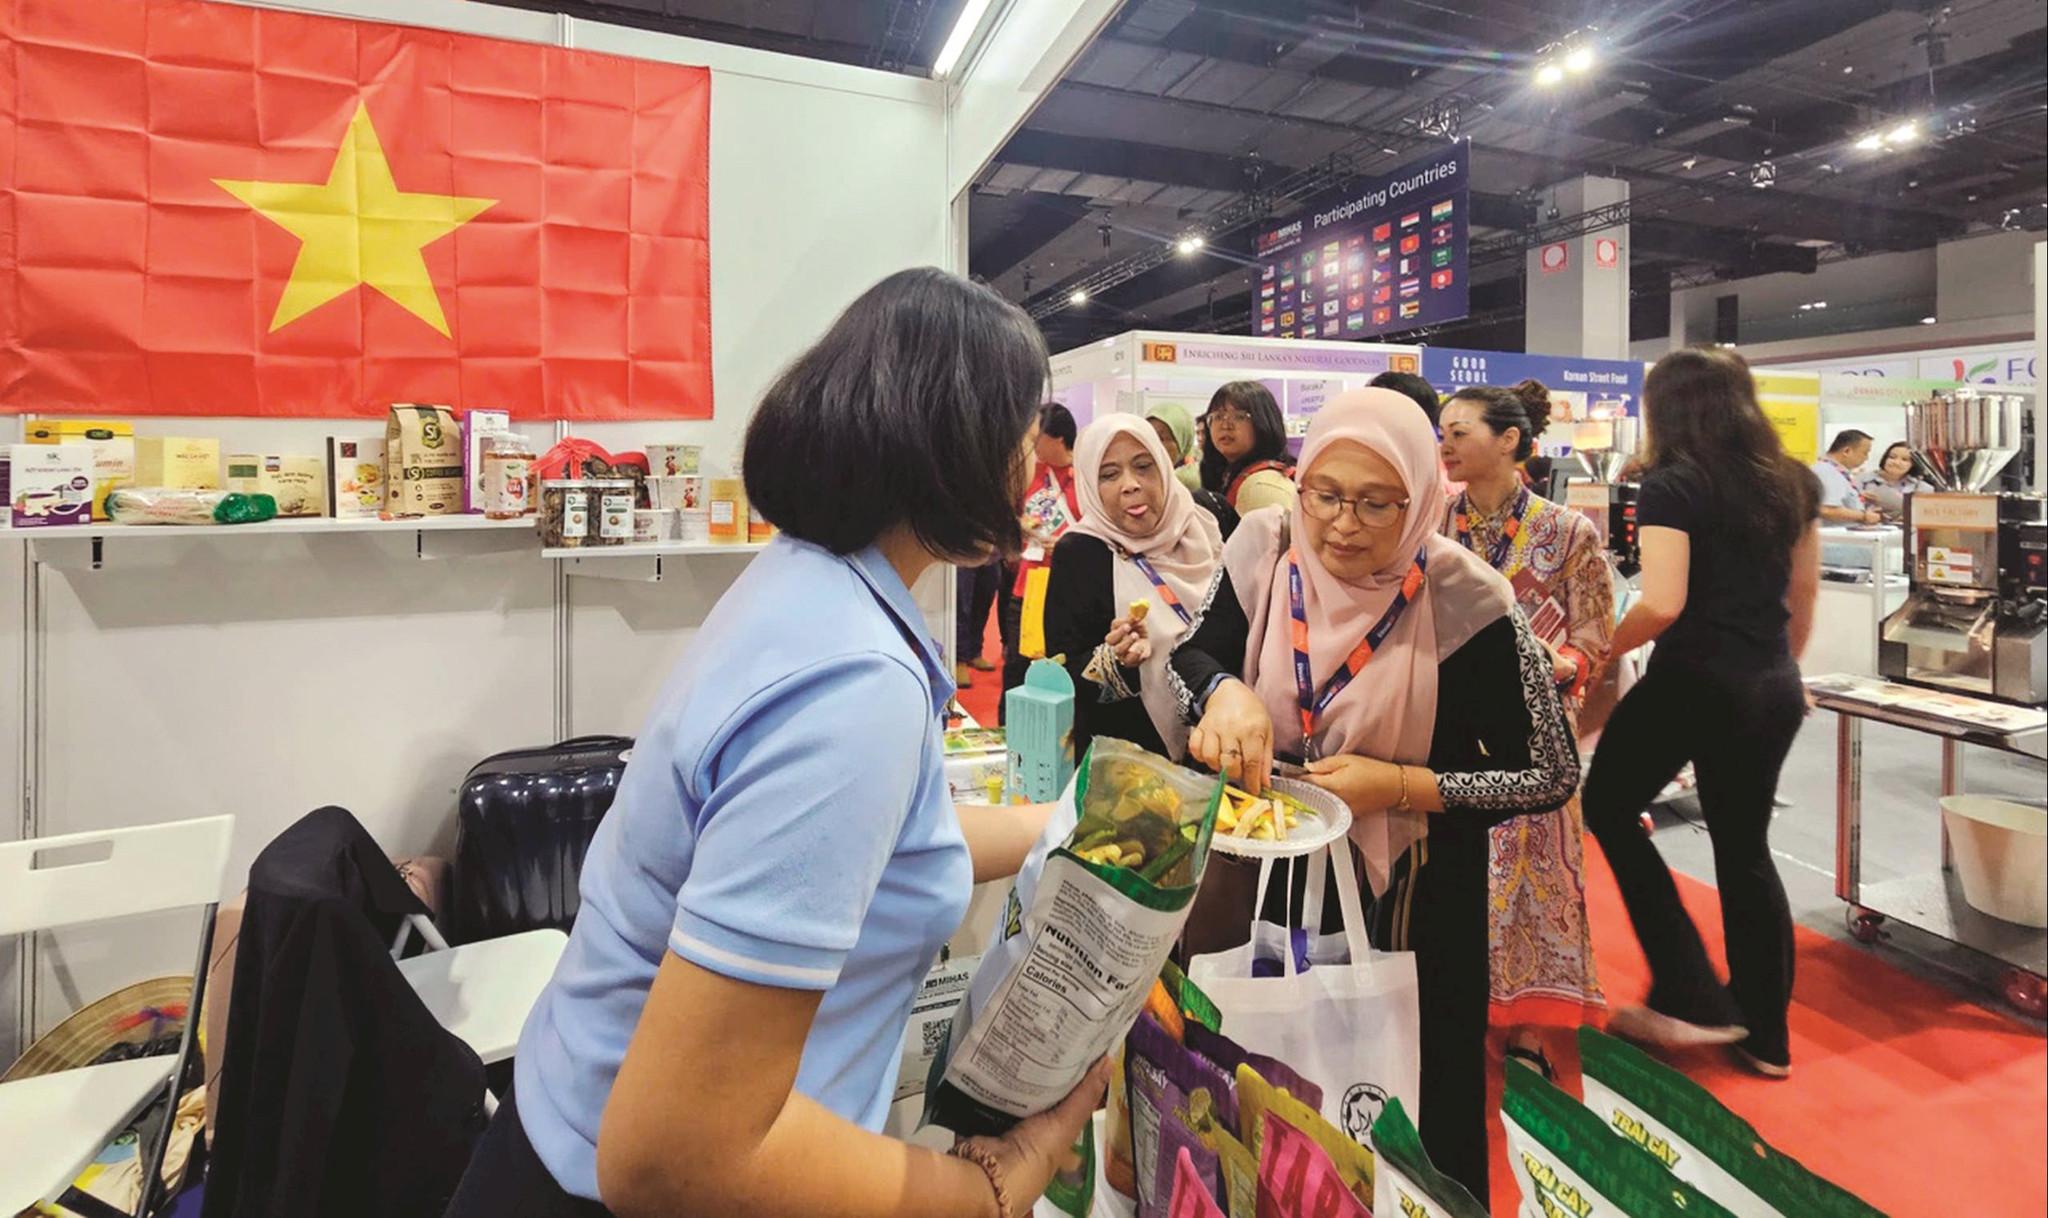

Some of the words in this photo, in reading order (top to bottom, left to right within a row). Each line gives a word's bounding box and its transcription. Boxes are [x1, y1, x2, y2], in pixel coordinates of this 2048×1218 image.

[1313, 188, 1387, 229] Participating
[1388, 160, 1457, 199] Countries
[1453, 356, 1486, 369] GOOD
[1450, 370, 1488, 383] SEOUL
[1563, 370, 1588, 382] Korean
[1589, 371, 1610, 383] Street
[1611, 373, 1628, 384] Food
[1045, 924, 1103, 978] Nutrition
[938, 971, 969, 986] MIHAS
[1026, 965, 1067, 994] Calories
